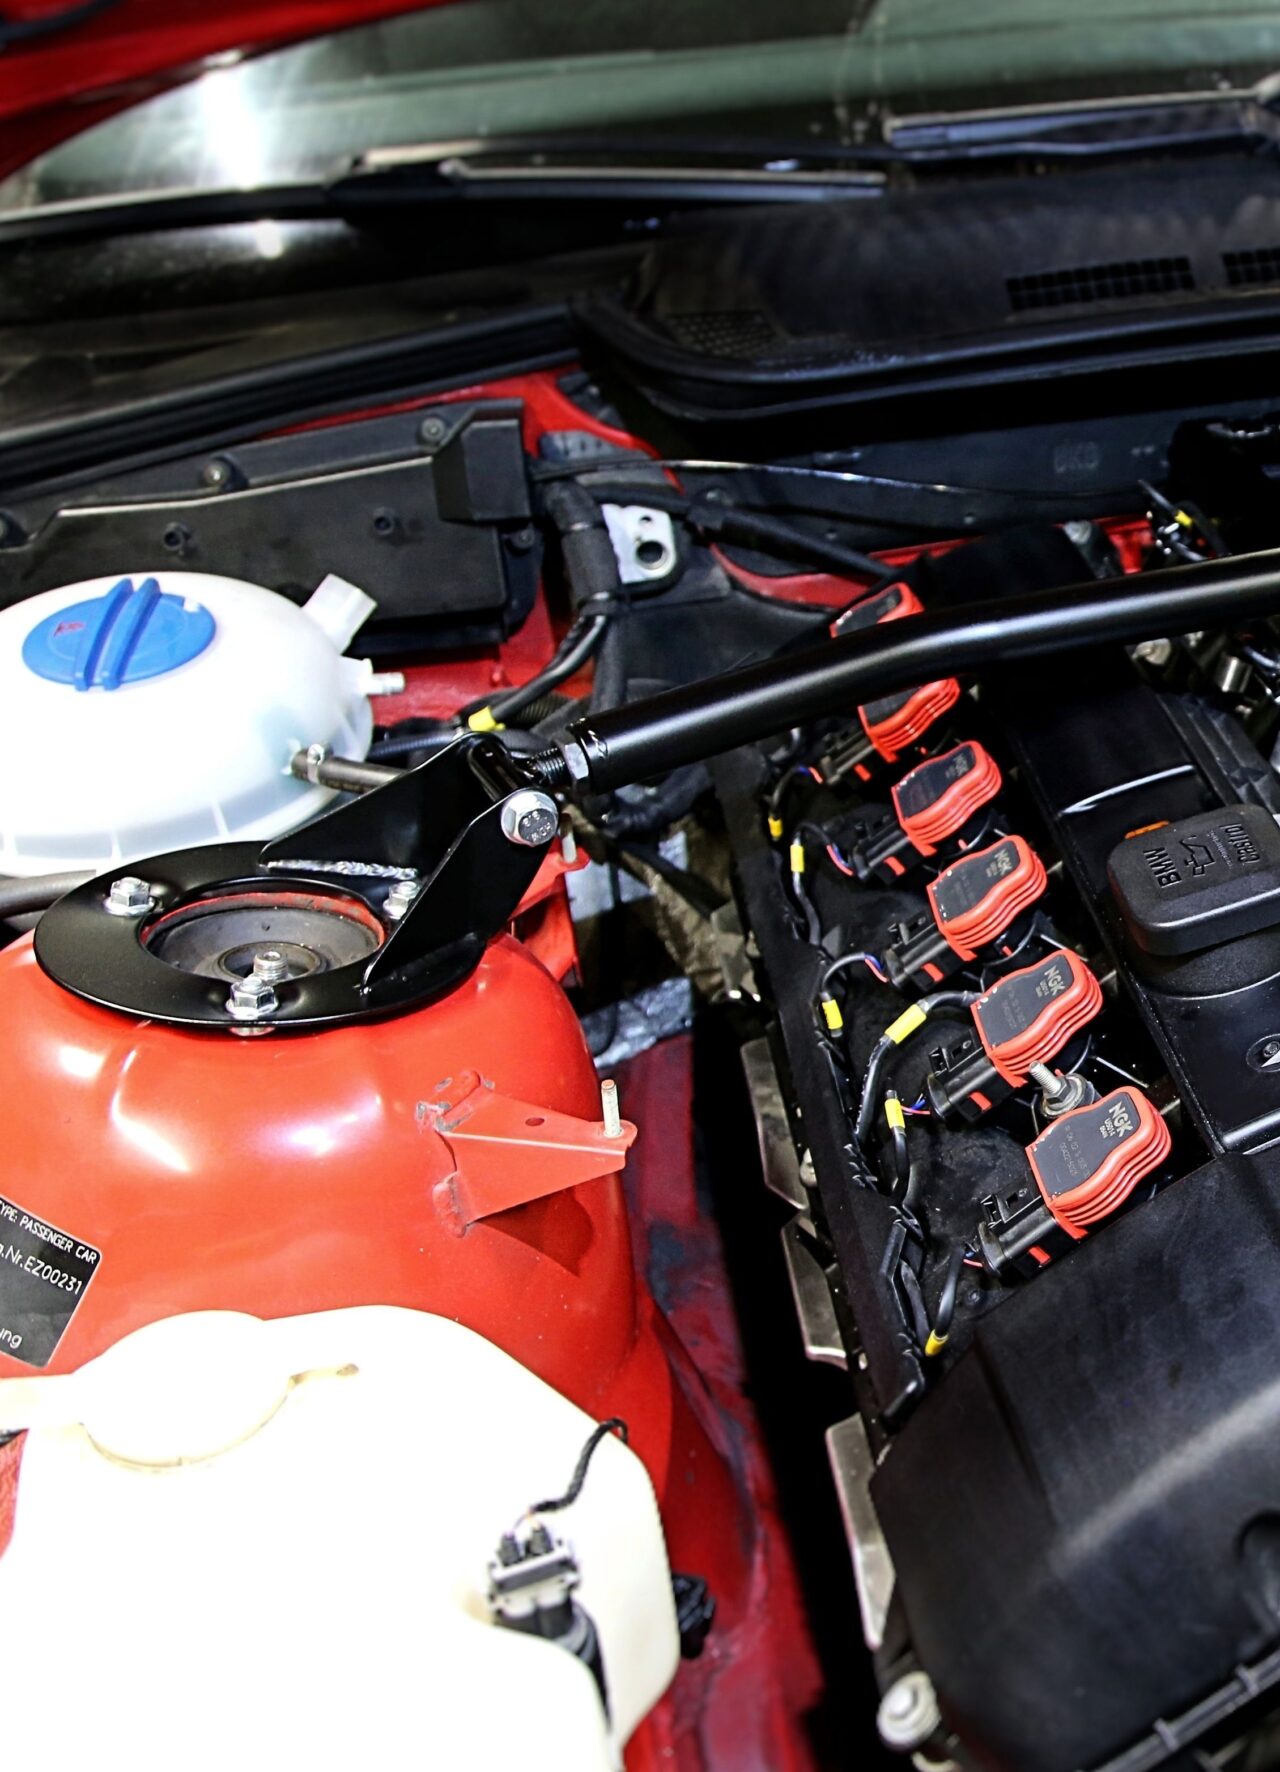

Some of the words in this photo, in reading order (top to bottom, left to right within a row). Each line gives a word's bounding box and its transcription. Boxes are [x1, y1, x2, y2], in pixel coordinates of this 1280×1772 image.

[1218, 823, 1261, 865] Castrol
[1143, 847, 1182, 889] BMW
[1044, 965, 1066, 996] NGK
[1108, 1101, 1134, 1138] NGK
[0, 1200, 18, 1224] YPE:
[19, 1214, 74, 1253] PASSENGER
[75, 1245, 98, 1265] CAR
